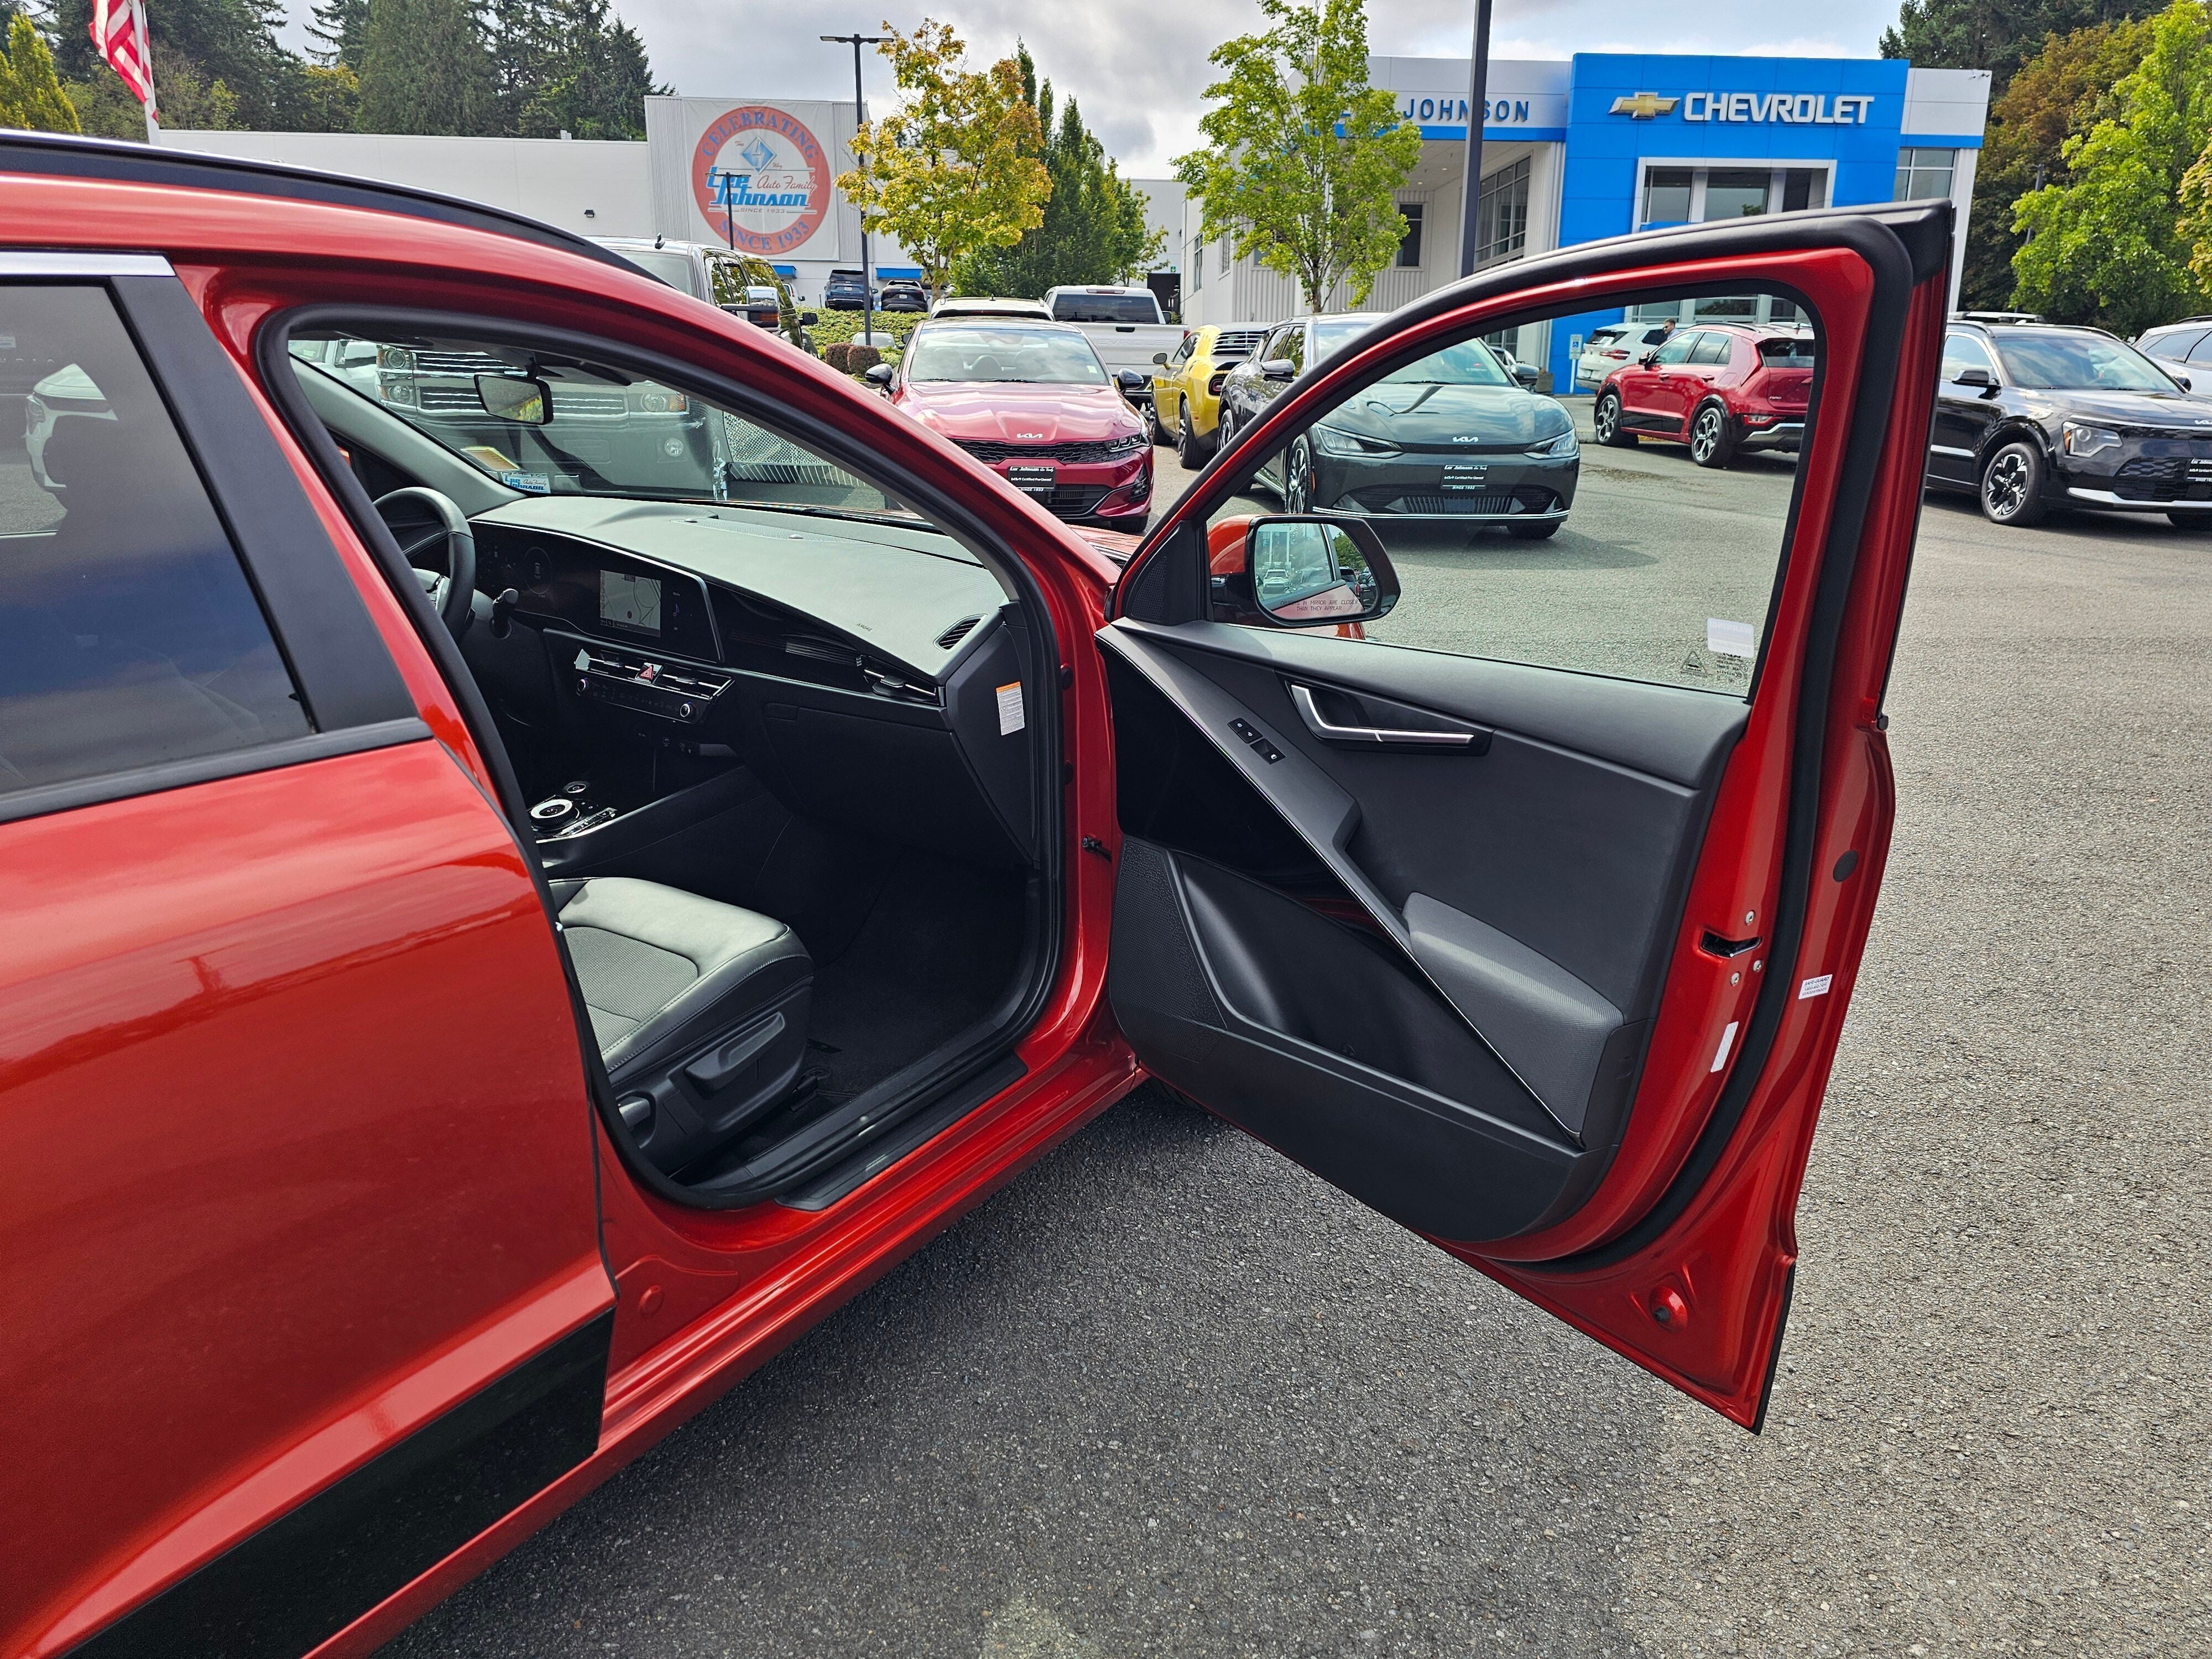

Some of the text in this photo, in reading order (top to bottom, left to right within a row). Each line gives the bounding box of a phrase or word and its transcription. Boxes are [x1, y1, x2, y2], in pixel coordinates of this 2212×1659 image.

[1684, 92, 1875, 124] CHEVROLET
[702, 112, 818, 159] CELEBRATING
[711, 178, 810, 206] Johnson
[757, 175, 781, 189] Auto
[783, 175, 817, 194] Family
[718, 220, 809, 250] SNCE 1933
